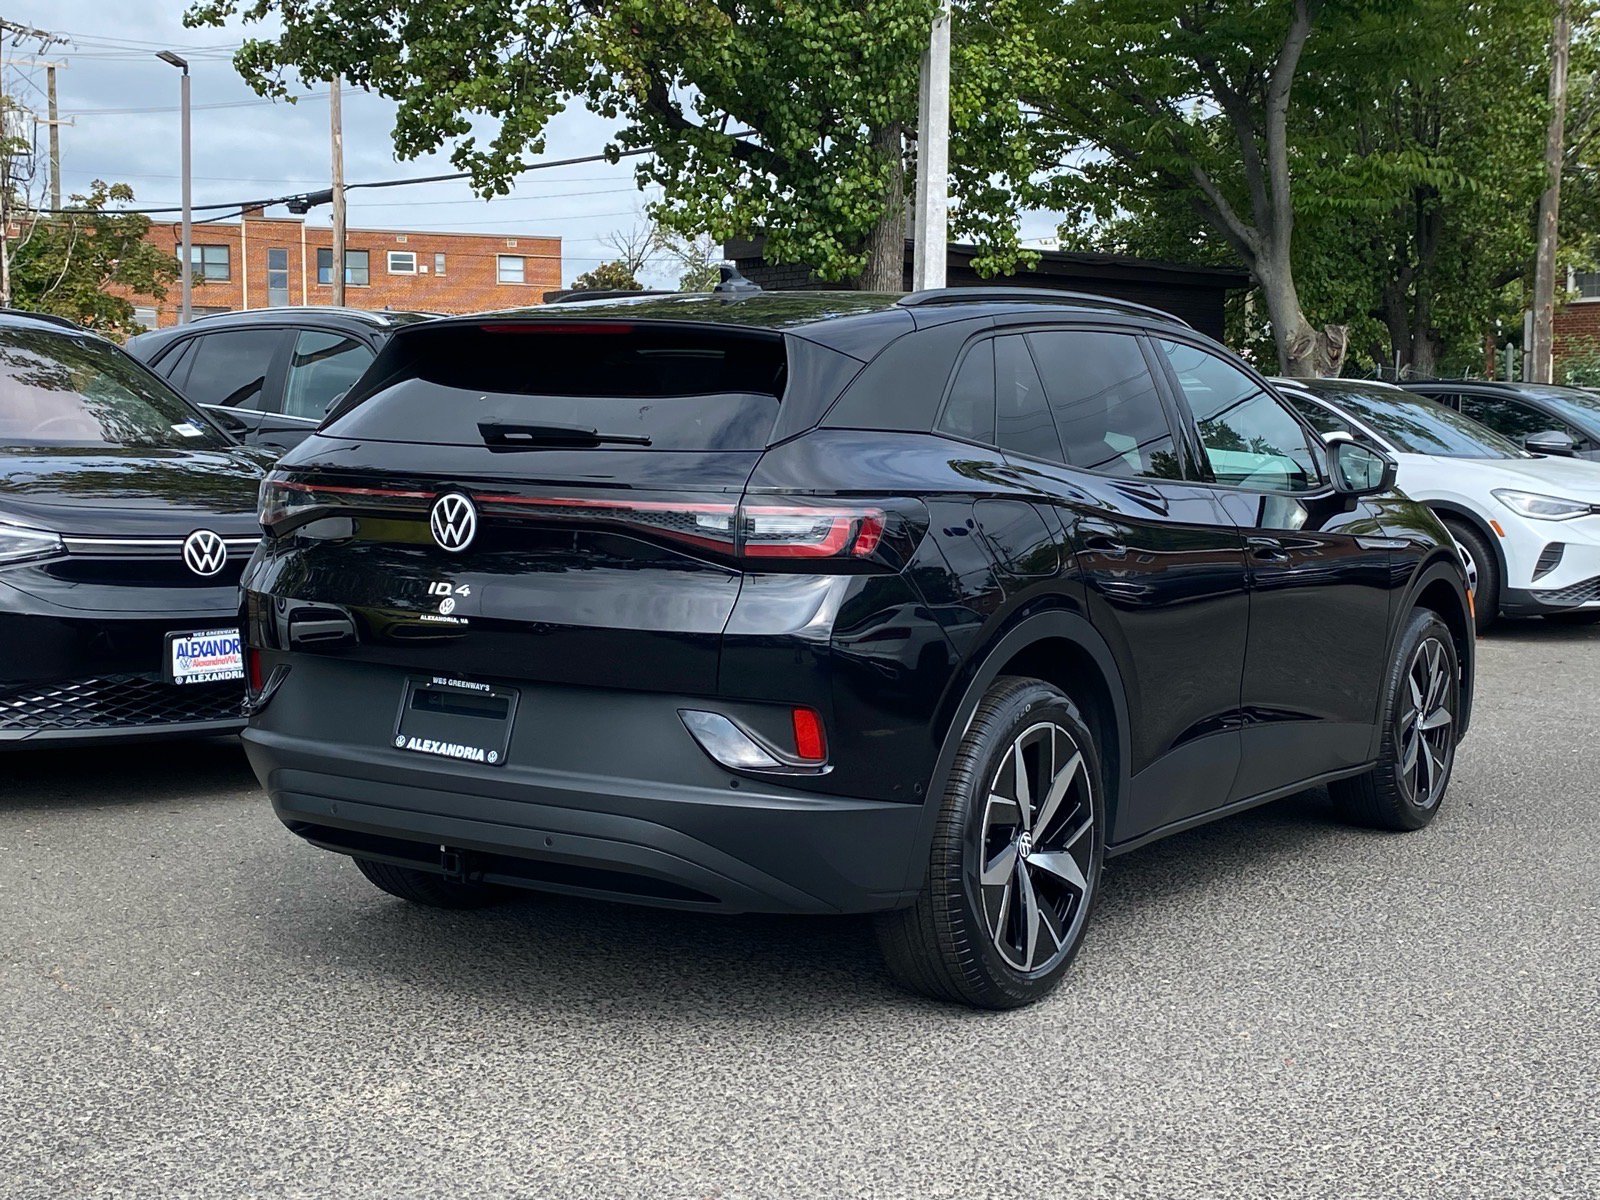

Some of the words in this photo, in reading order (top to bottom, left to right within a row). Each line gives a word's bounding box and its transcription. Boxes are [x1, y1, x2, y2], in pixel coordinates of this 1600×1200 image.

[432, 676, 447, 685] WES
[448, 679, 490, 691] GREENWAY'S
[406, 737, 485, 762] ALEXANDRIA
